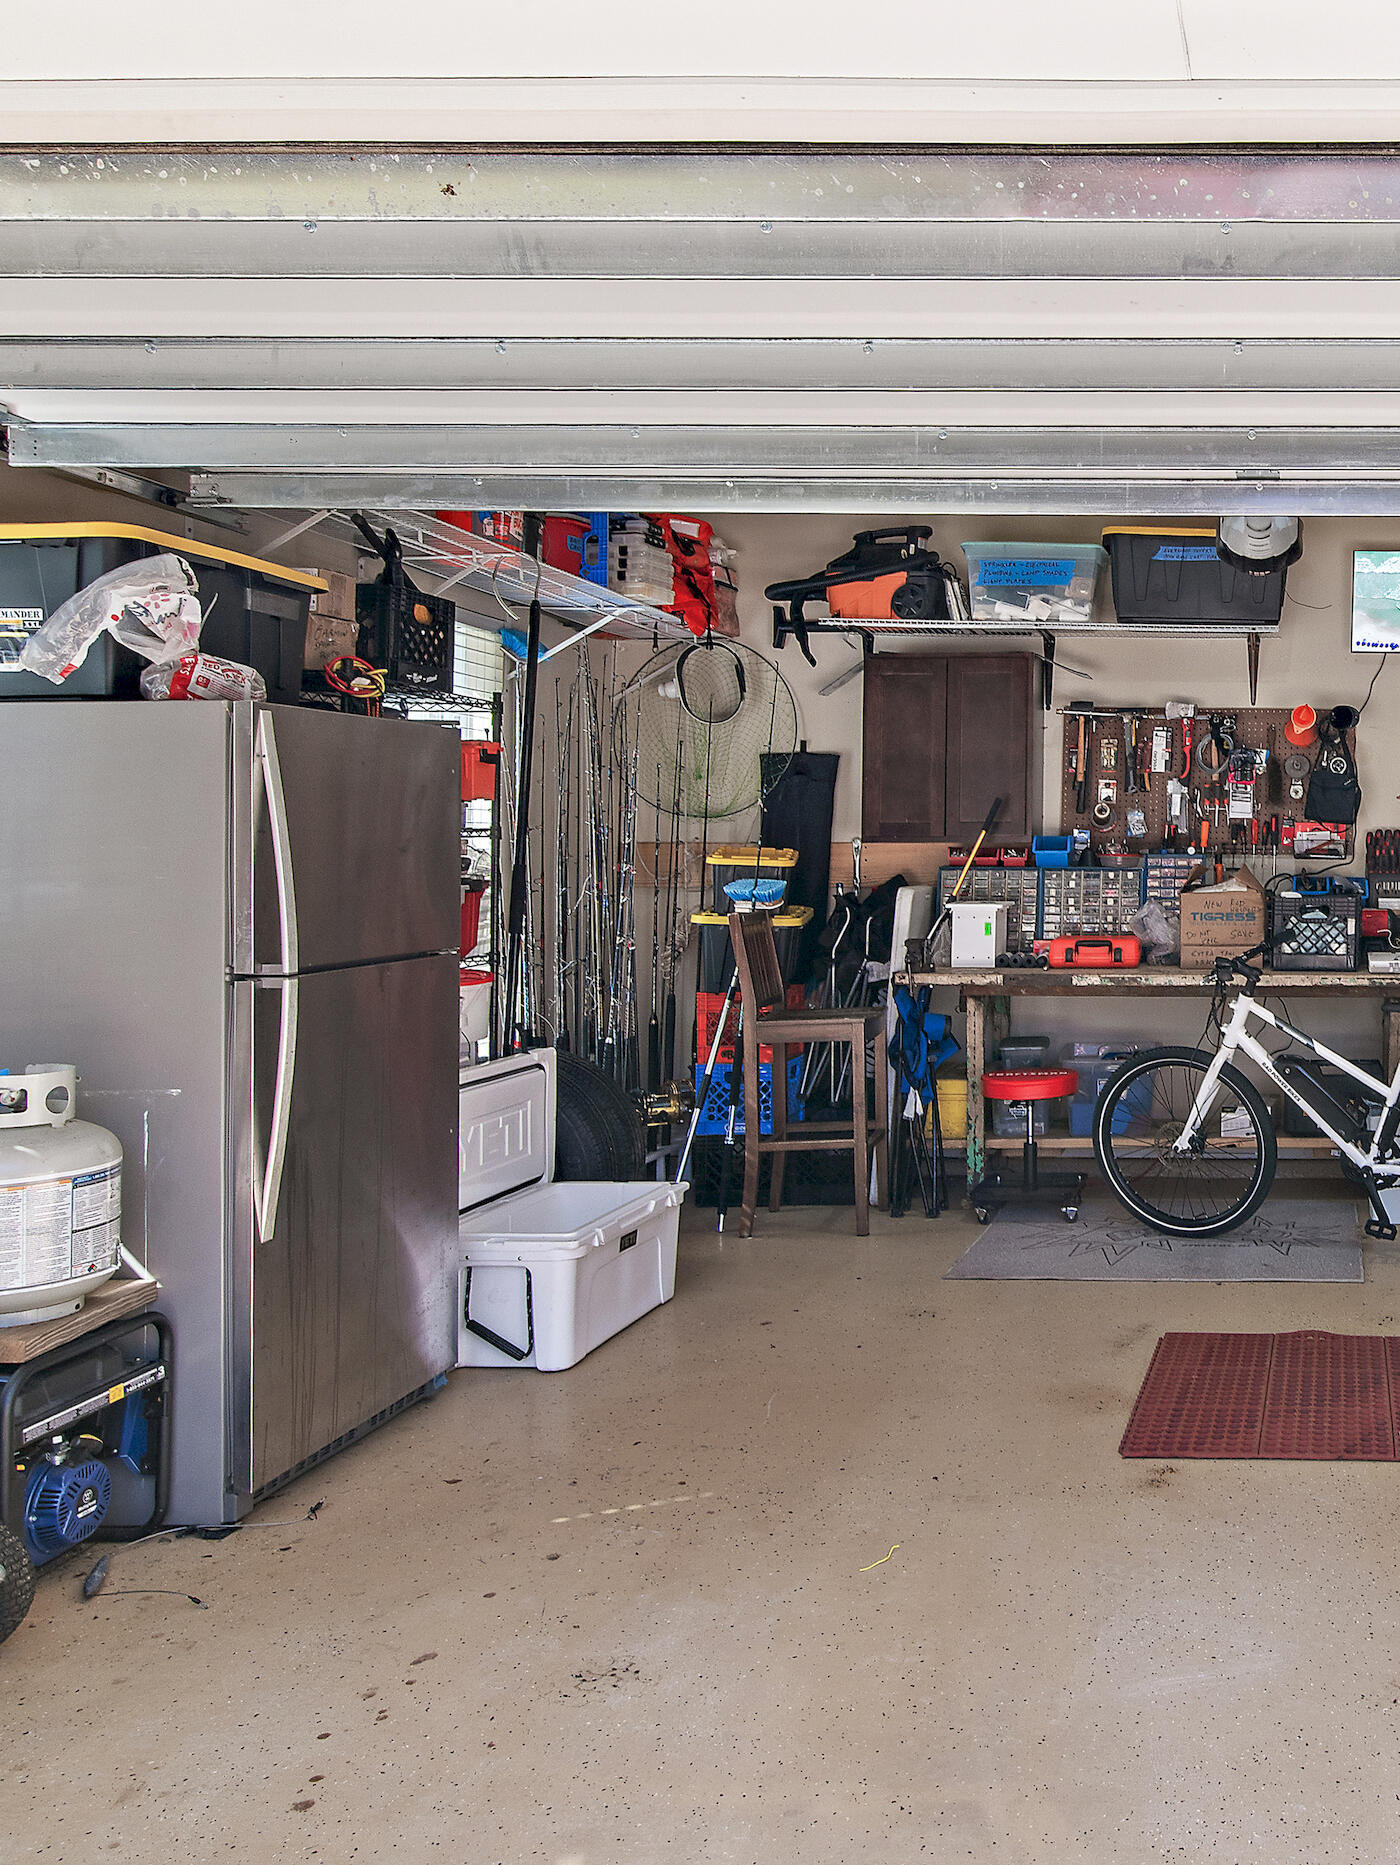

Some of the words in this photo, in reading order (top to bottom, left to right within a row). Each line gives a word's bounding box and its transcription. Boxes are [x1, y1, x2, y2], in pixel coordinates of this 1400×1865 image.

[24, 621, 41, 629] XXL
[1190, 911, 1257, 922] TIGRESS
[1272, 1072, 1288, 1089] POWER
[459, 1099, 532, 1174] YETI
[156, 1365, 165, 1379] 3
